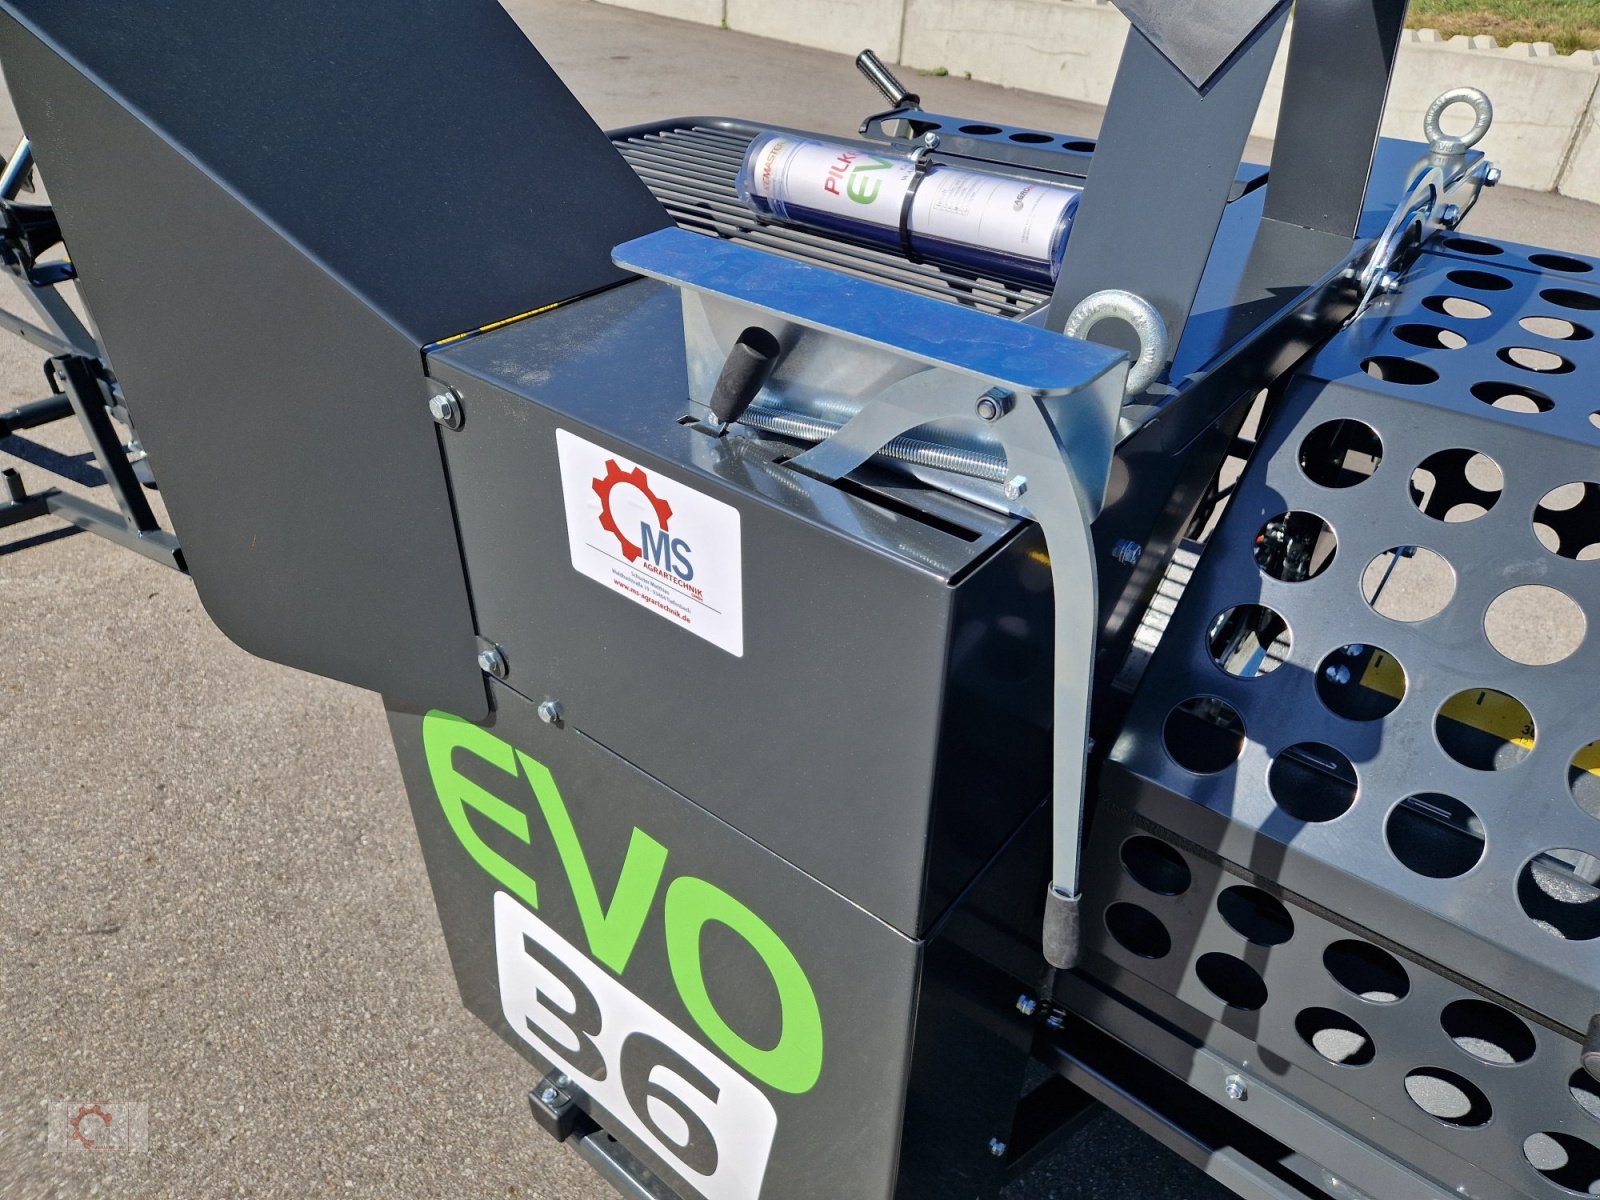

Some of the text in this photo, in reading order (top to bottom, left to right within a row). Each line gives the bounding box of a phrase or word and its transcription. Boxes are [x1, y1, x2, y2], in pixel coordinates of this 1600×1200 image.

[640, 520, 694, 582] MS
[643, 561, 703, 597] AGRARTECHNIK
[613, 579, 691, 624] www.ms-agrartechnik.de
[422, 708, 823, 1094] EVO
[522, 931, 721, 1177] 36
